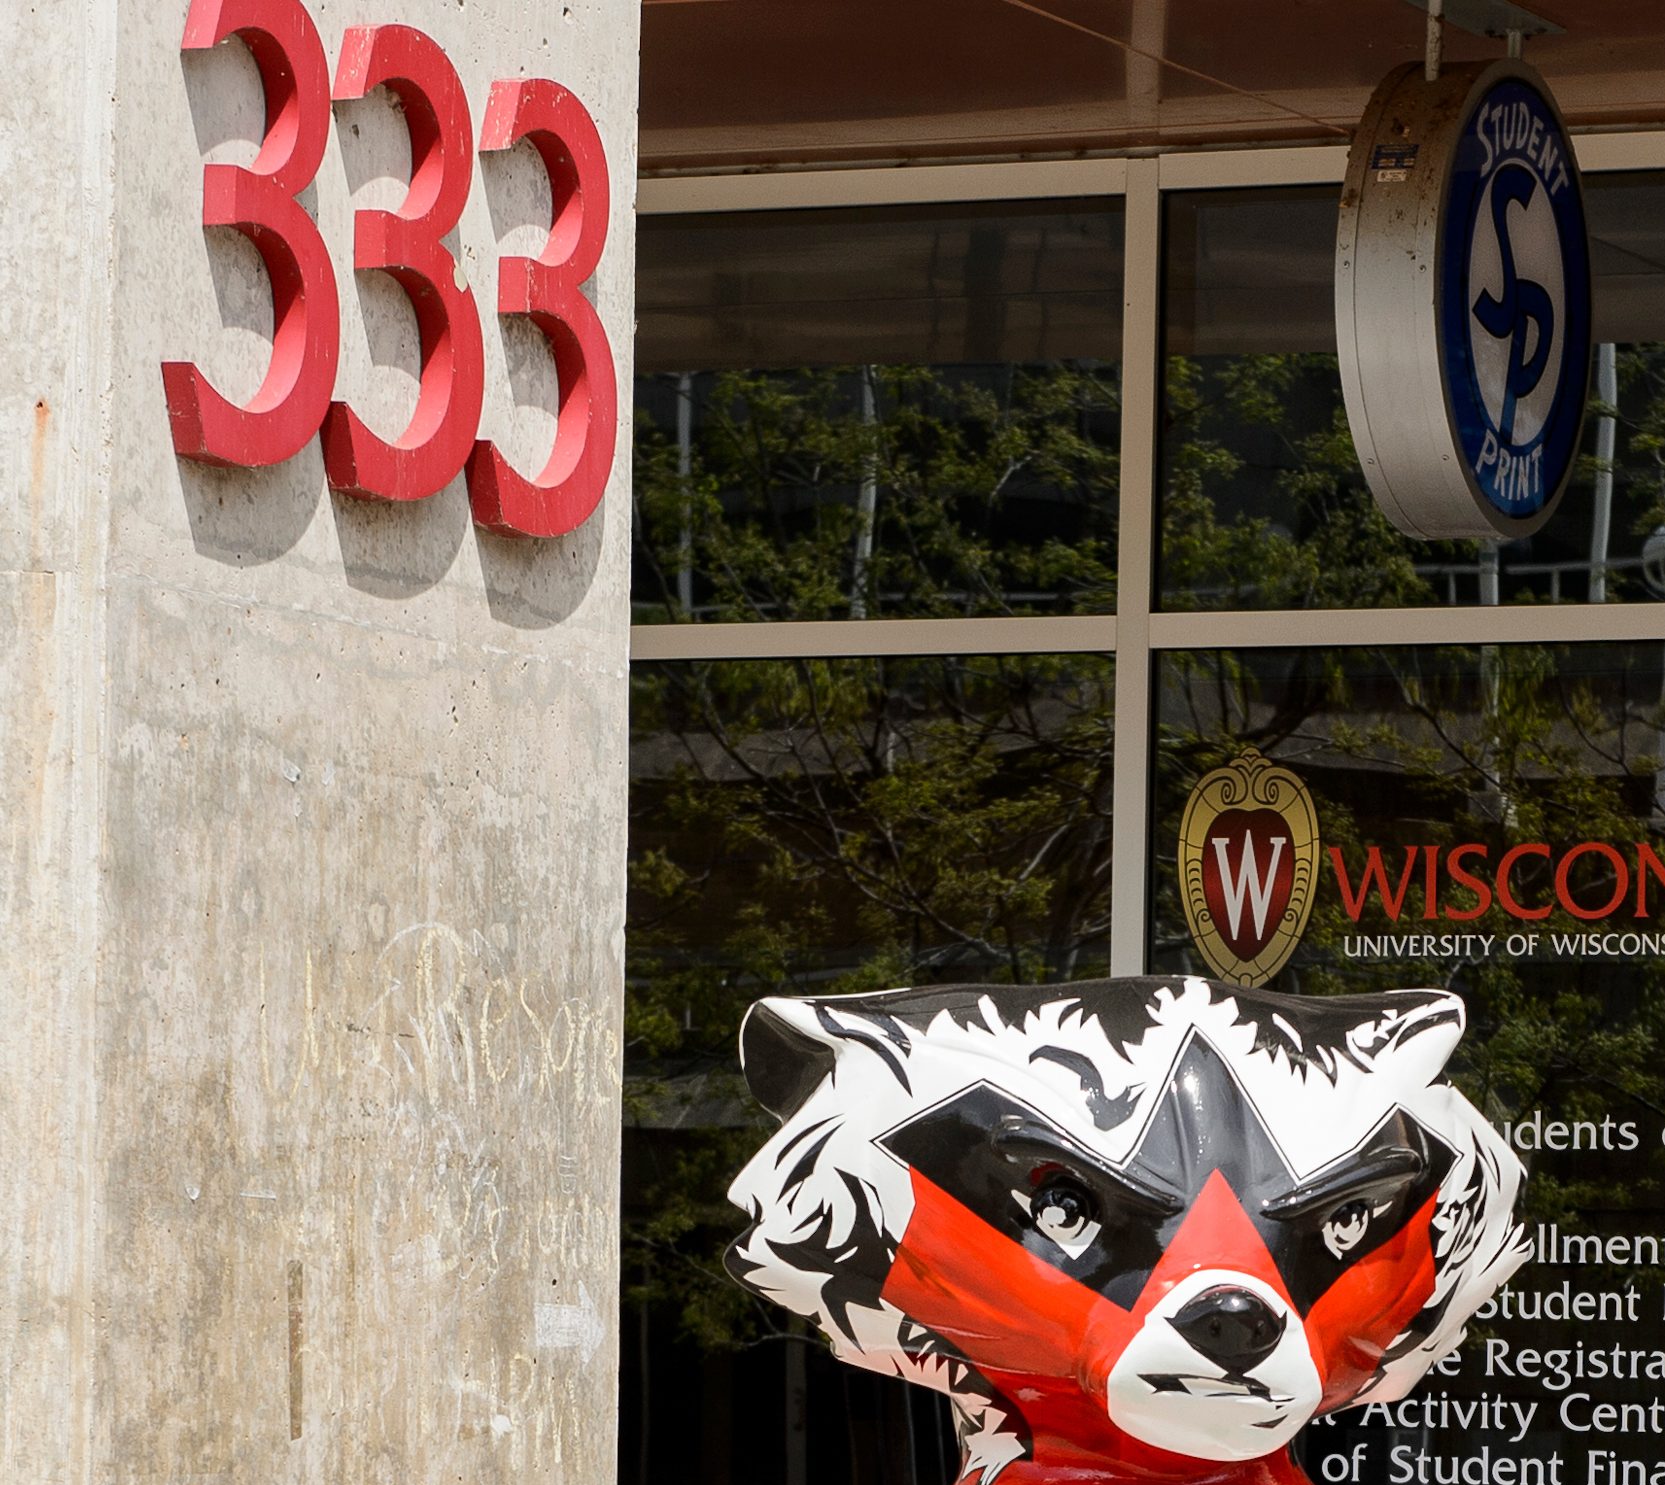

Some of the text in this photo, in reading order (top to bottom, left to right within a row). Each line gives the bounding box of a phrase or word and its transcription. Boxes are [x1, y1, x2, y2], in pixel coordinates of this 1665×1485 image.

[1477, 101, 1570, 197] STUDENT
[161, 0, 618, 539] 333
[1475, 428, 1543, 500] PRINT
[1211, 829, 1285, 942] W
[1343, 934, 1495, 958] UNIVERSITY
[1506, 934, 1541, 957] OF
[1360, 1393, 1538, 1442] Activity
[1321, 1443, 1367, 1483] of
